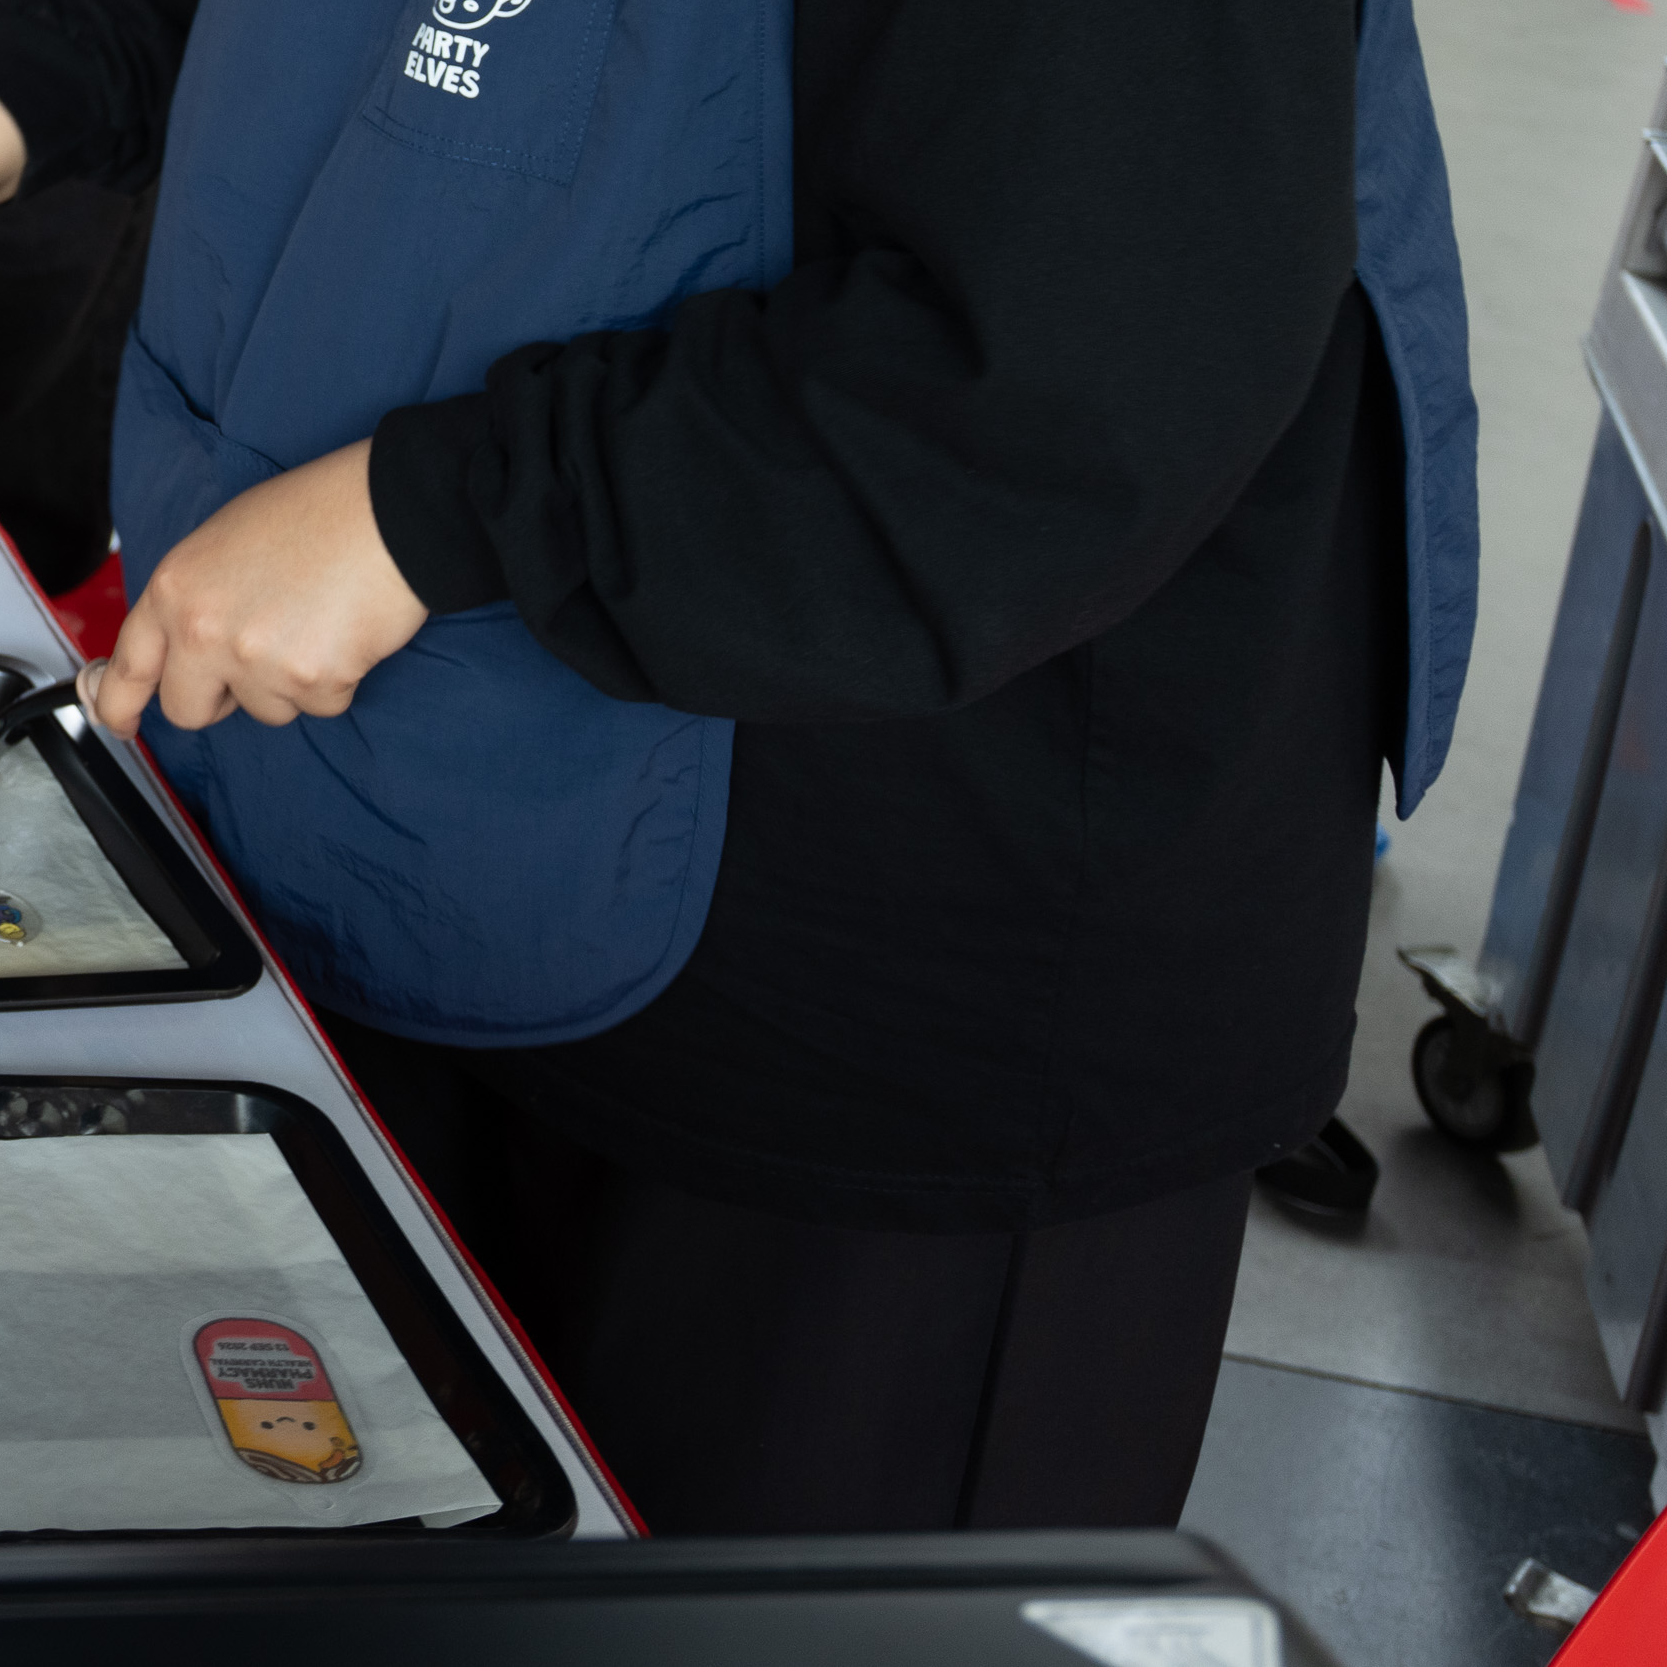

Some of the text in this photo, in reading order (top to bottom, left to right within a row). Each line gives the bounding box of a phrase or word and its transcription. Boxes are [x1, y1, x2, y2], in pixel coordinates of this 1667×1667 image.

[411, 22, 490, 68] PARTY
[404, 50, 481, 99] ELVES
[217, 1367, 314, 1379] PHARMACY
[244, 1378, 295, 1390] NUHS
